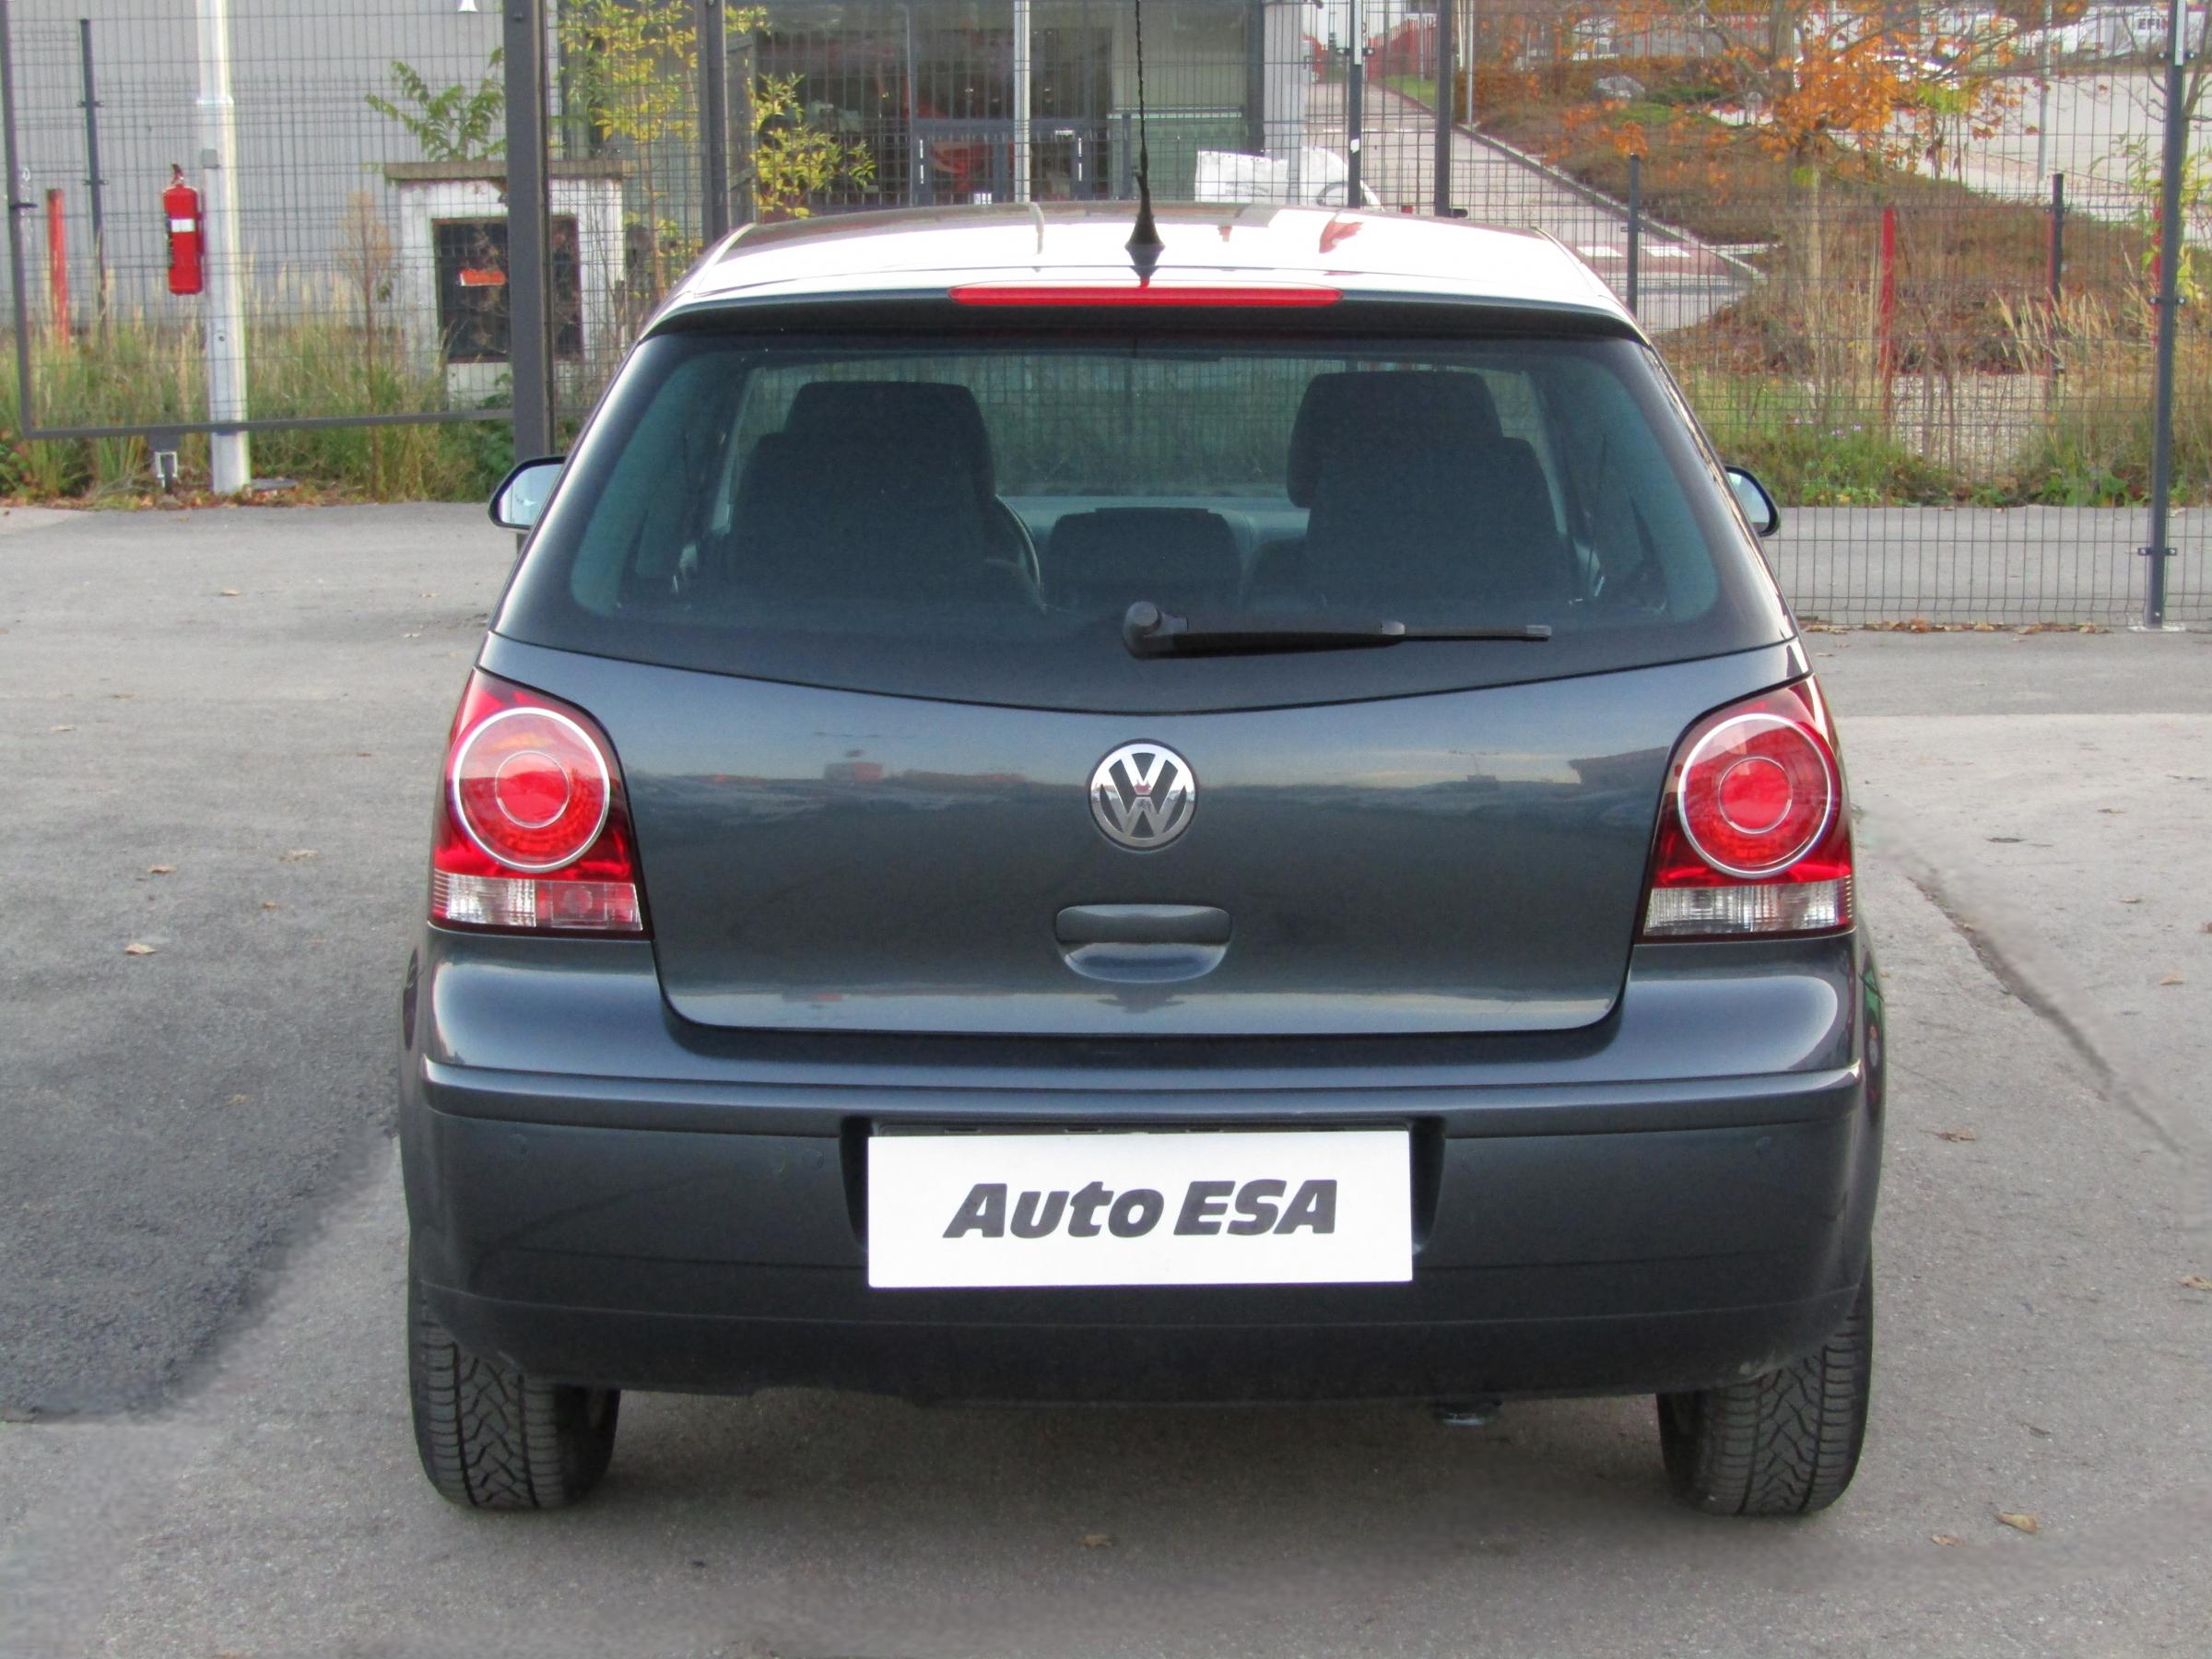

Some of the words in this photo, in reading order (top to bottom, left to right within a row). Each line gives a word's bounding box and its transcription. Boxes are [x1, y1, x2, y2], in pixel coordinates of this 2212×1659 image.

[1090, 742, 1196, 848] VW
[944, 1182, 1163, 1238] Auto
[1174, 1180, 1336, 1235] ESA
